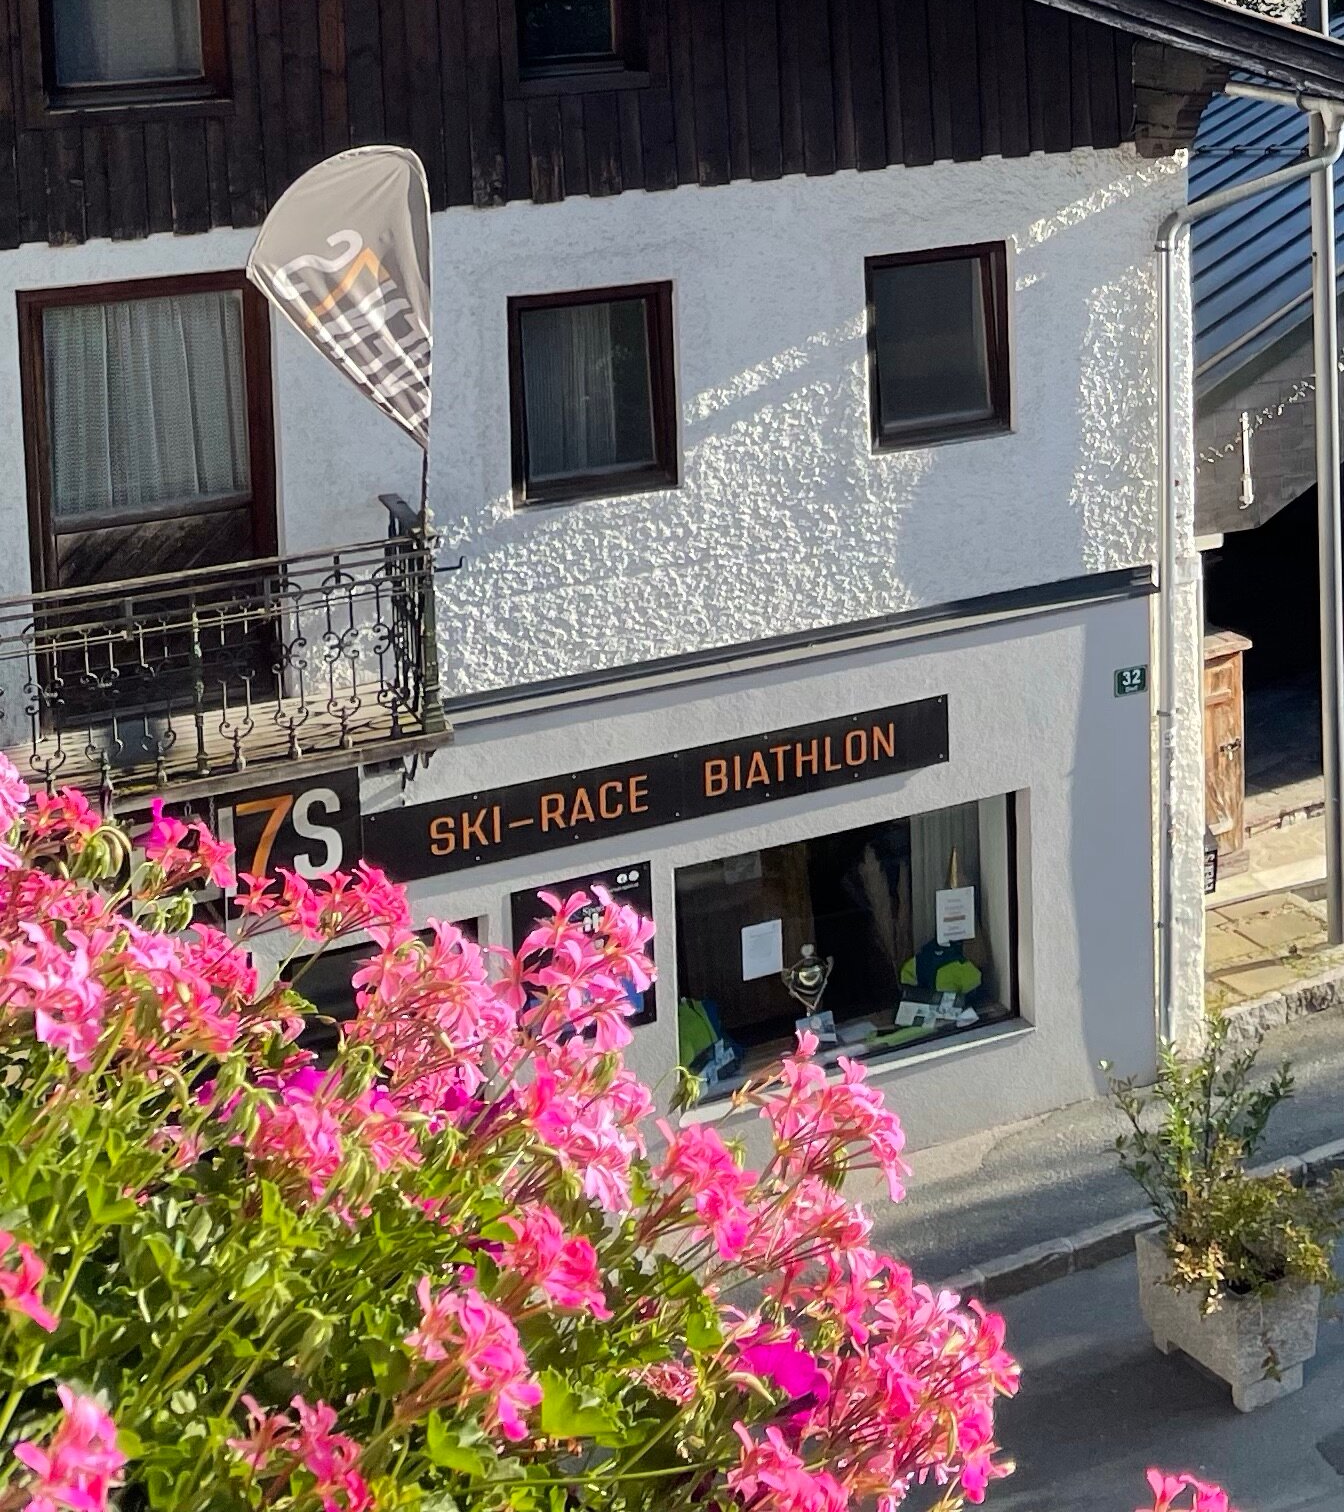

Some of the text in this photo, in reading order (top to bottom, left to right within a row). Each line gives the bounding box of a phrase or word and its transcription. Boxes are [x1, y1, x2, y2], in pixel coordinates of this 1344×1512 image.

[1122, 669, 1141, 686] 32
[428, 721, 896, 858] SKI-RACE BIATHLON
